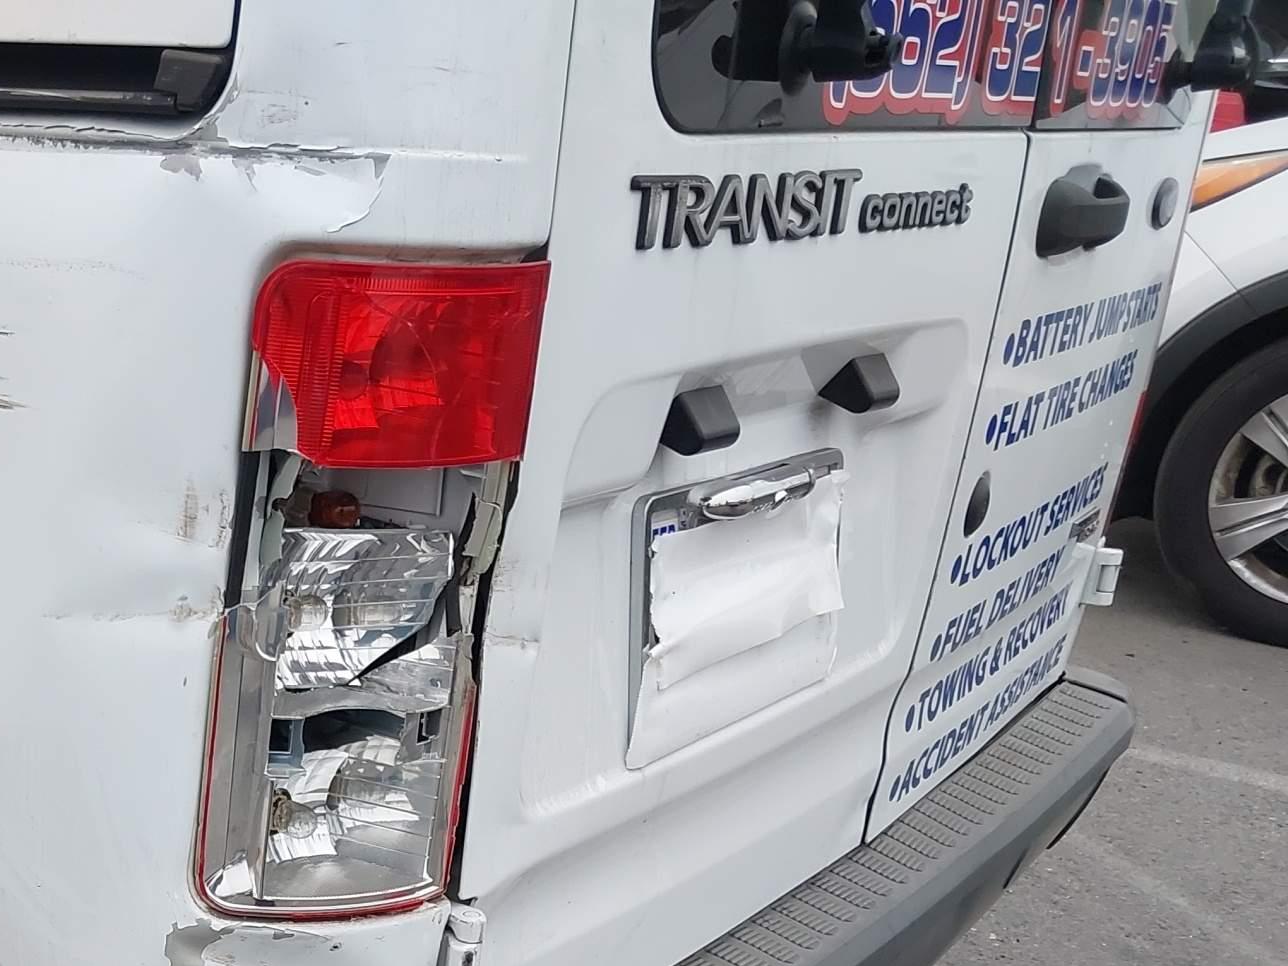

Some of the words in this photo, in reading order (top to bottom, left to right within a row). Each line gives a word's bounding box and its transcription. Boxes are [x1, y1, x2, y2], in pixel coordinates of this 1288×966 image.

[630, 168, 862, 250] TRANSIT
[858, 182, 974, 234] connect
[1012, 302, 1094, 367] BATTERY
[1088, 292, 1128, 344] JUMP
[993, 392, 1045, 451] FLAT
[1042, 376, 1082, 430] TIRE
[1077, 348, 1139, 413] CHANGES
[958, 501, 1050, 587] LOCKOUT
[1043, 461, 1109, 536] SERVICES
[917, 645, 991, 731] TOWING
[989, 636, 1004, 676] &
[1003, 581, 1073, 665] RECOVERY
[937, 599, 987, 662] FUEL
[985, 546, 1065, 630] DELIVERY
[896, 700, 991, 802] ACCIDENT
[983, 633, 1068, 731] ASSISTANCE
